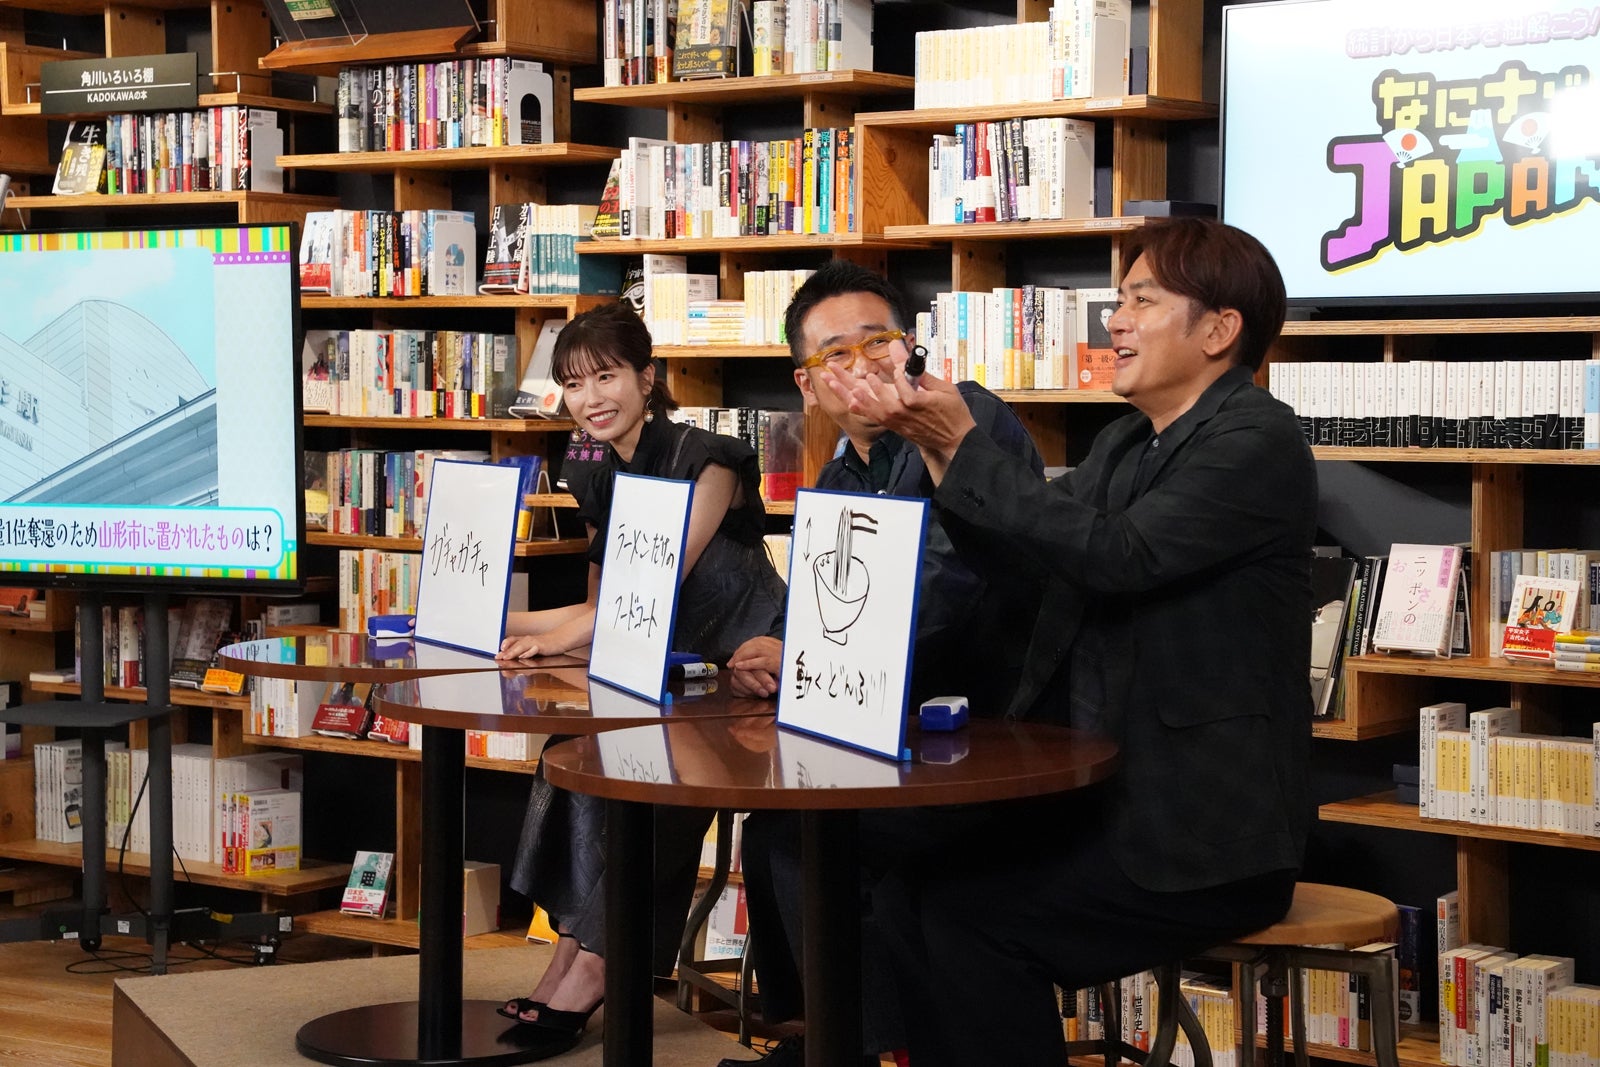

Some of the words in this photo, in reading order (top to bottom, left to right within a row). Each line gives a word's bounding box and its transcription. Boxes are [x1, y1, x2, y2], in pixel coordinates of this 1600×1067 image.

[81, 67, 154, 87] 角川いろいろ棚
[87, 90, 148, 103] KADOKAWAの本
[486, 206, 501, 264] 日本上陸
[566, 447, 604, 461] 水族館
[431, 522, 488, 587] ガチャガチャ
[616, 523, 675, 569] ラーメンだけの
[1403, 555, 1427, 625] ニッポンの
[613, 592, 658, 638] フードコート
[795, 650, 888, 717] 動くどんぶり
